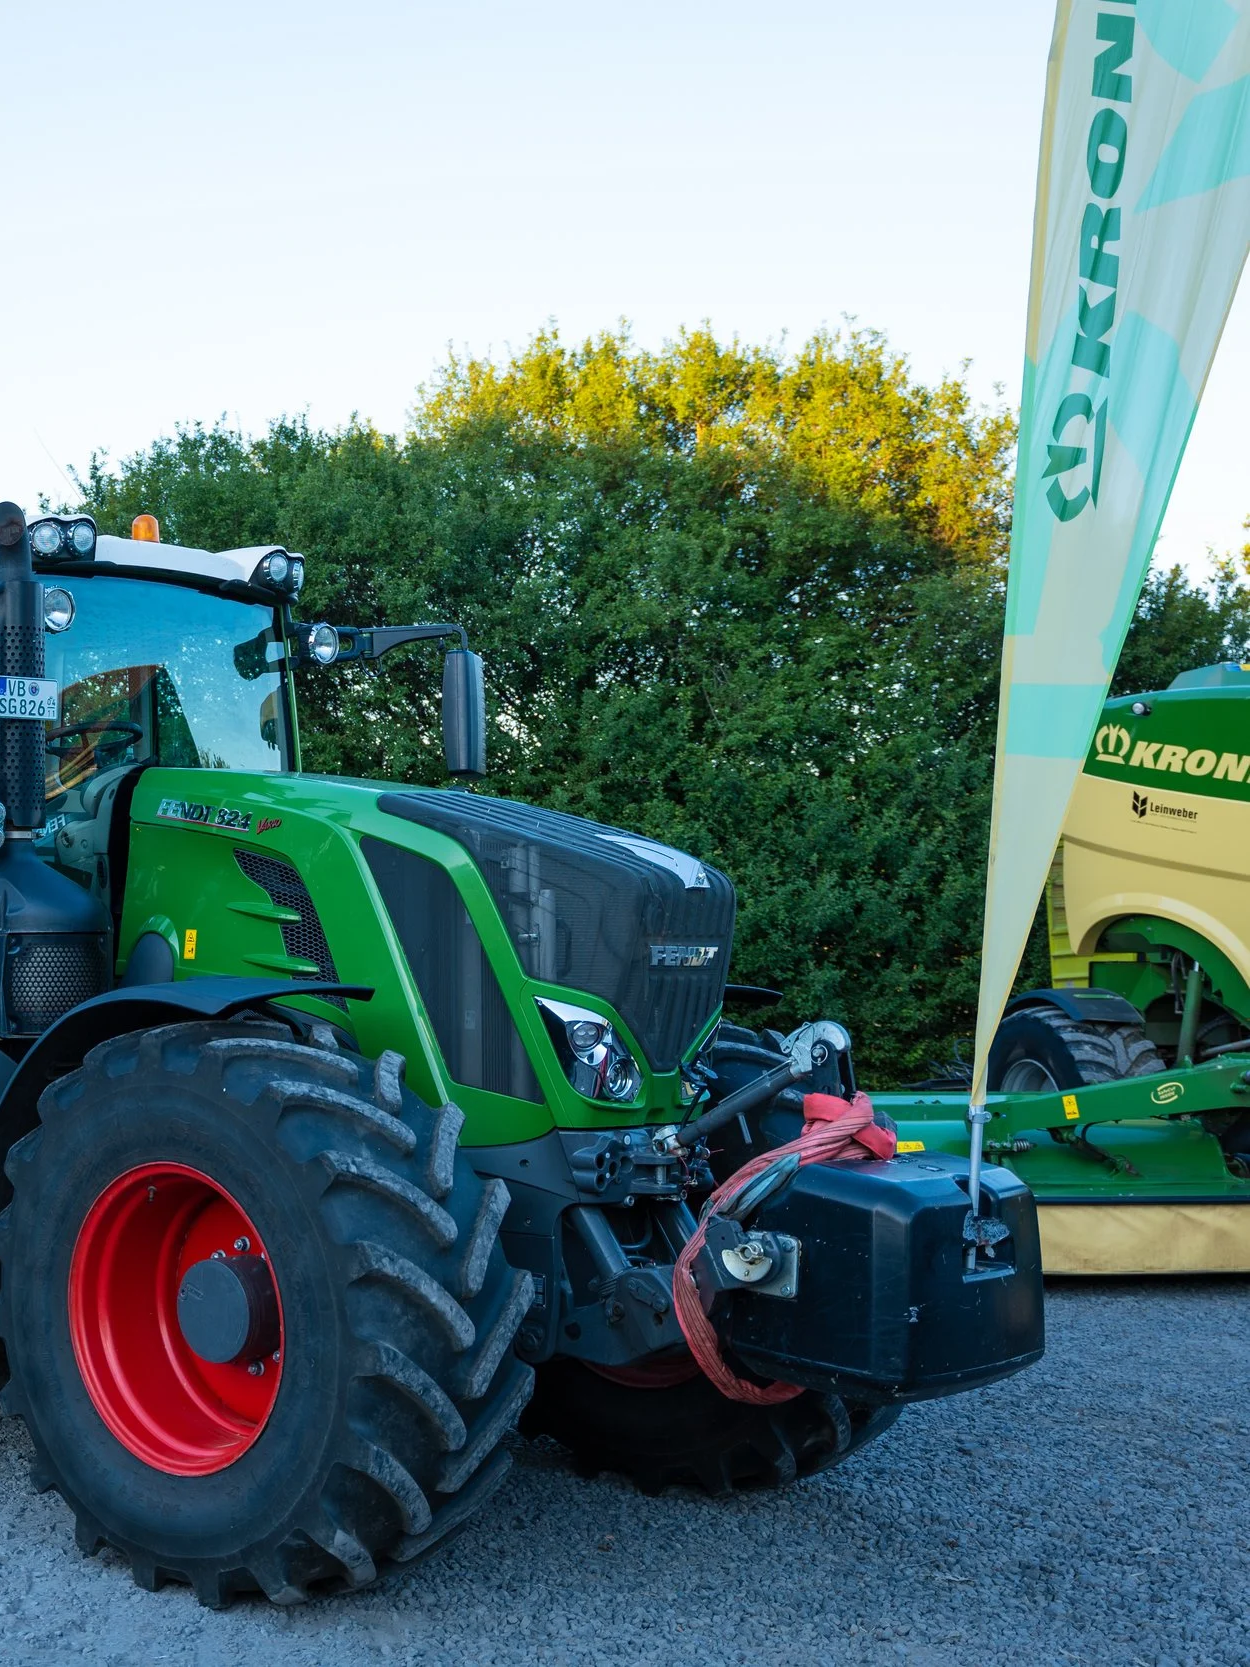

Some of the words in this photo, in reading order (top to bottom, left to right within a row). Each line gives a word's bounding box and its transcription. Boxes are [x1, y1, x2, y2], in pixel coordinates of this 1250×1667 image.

[1072, 0, 1136, 378] KRON
[8, 680, 26, 697] VB
[1129, 740, 1250, 784] KRON
[157, 799, 215, 823] FENDT
[215, 808, 252, 830] 824
[1150, 802, 1198, 820] Leinweber
[650, 945, 719, 966] FENDT
